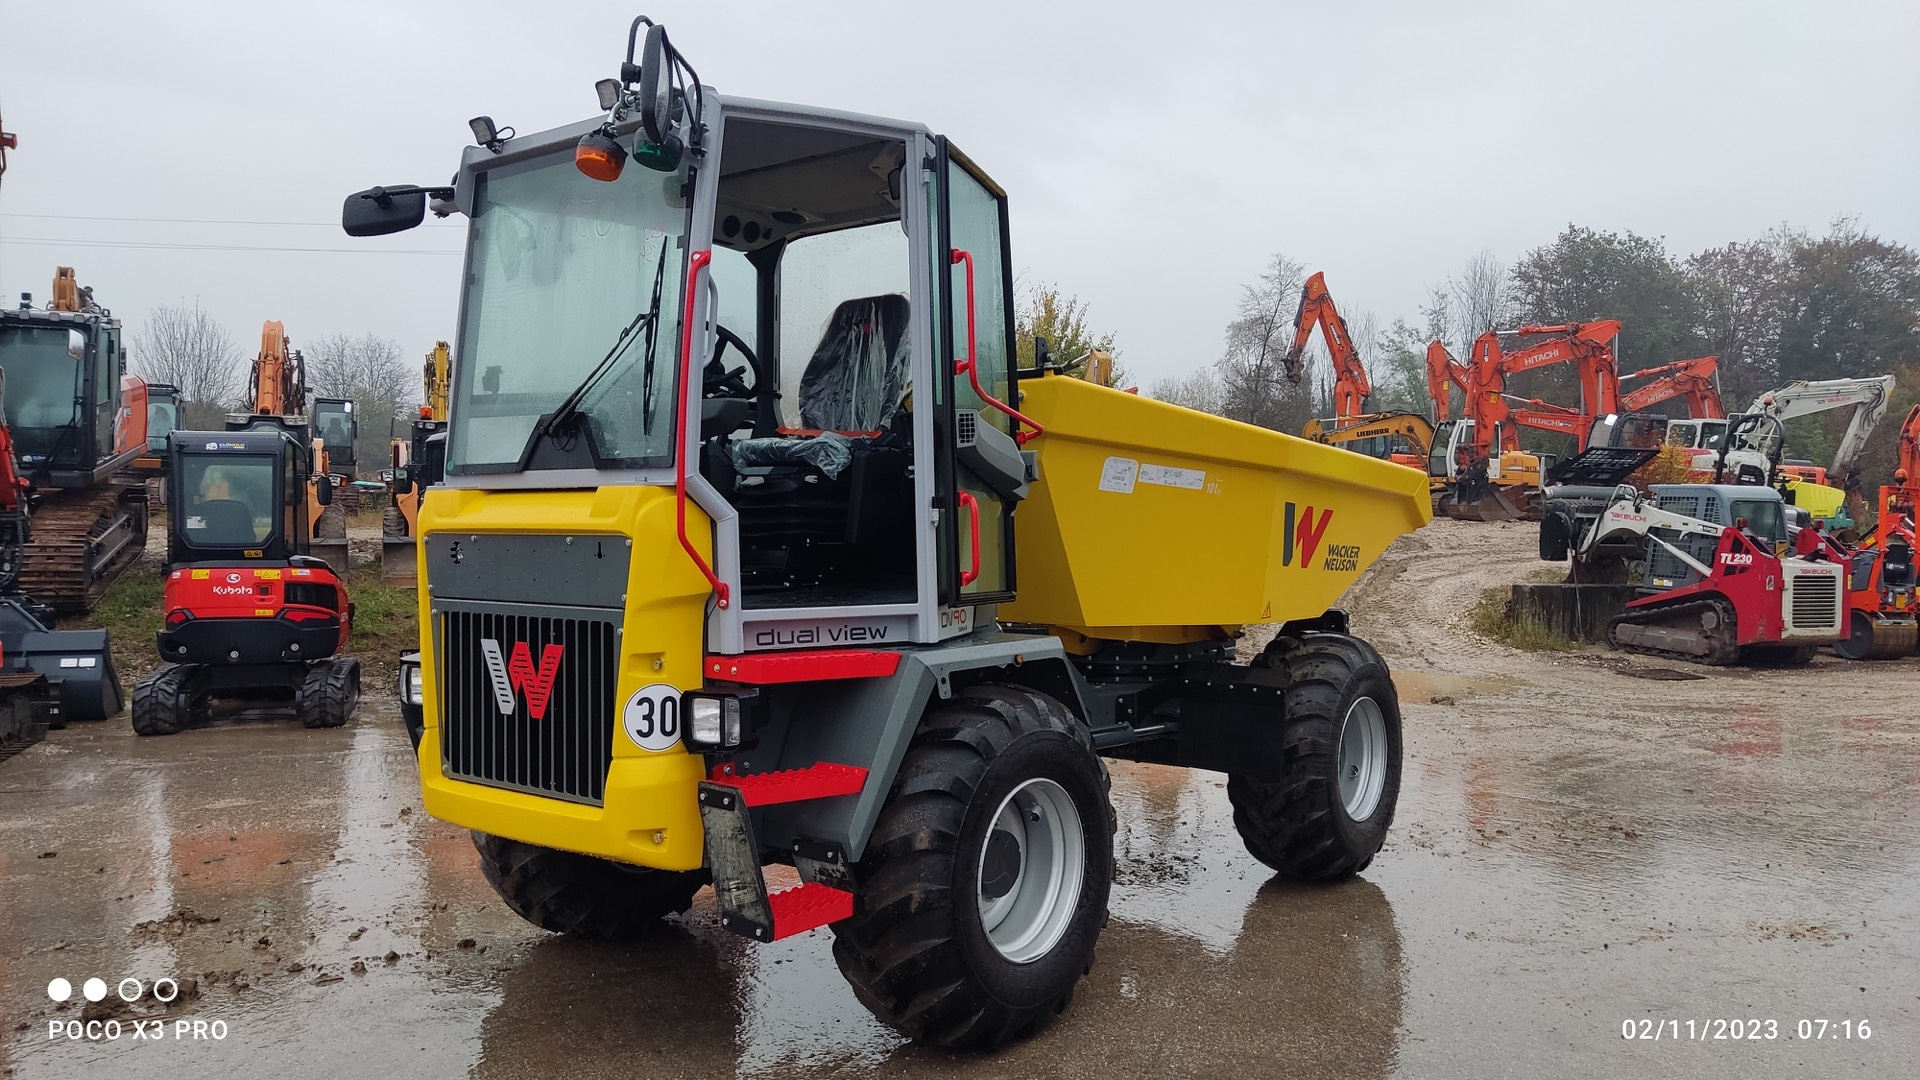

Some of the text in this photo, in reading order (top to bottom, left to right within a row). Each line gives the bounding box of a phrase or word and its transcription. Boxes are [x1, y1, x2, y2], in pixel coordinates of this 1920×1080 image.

[1524, 349, 1560, 366] HITACHI
[1647, 388, 1674, 404] HITACHI
[1528, 416, 1560, 426] HITACHI
[1356, 427, 1390, 438] LIEBHERR
[1610, 511, 1647, 523] TAKEUCHI
[1328, 544, 1360, 559] WACKER
[1323, 558, 1358, 572] NEUSON
[1720, 553, 1753, 565] TL230
[213, 585, 253, 595] Kubota
[941, 608, 967, 628] DV90
[756, 624, 888, 646] dual view
[635, 695, 678, 739] 30
